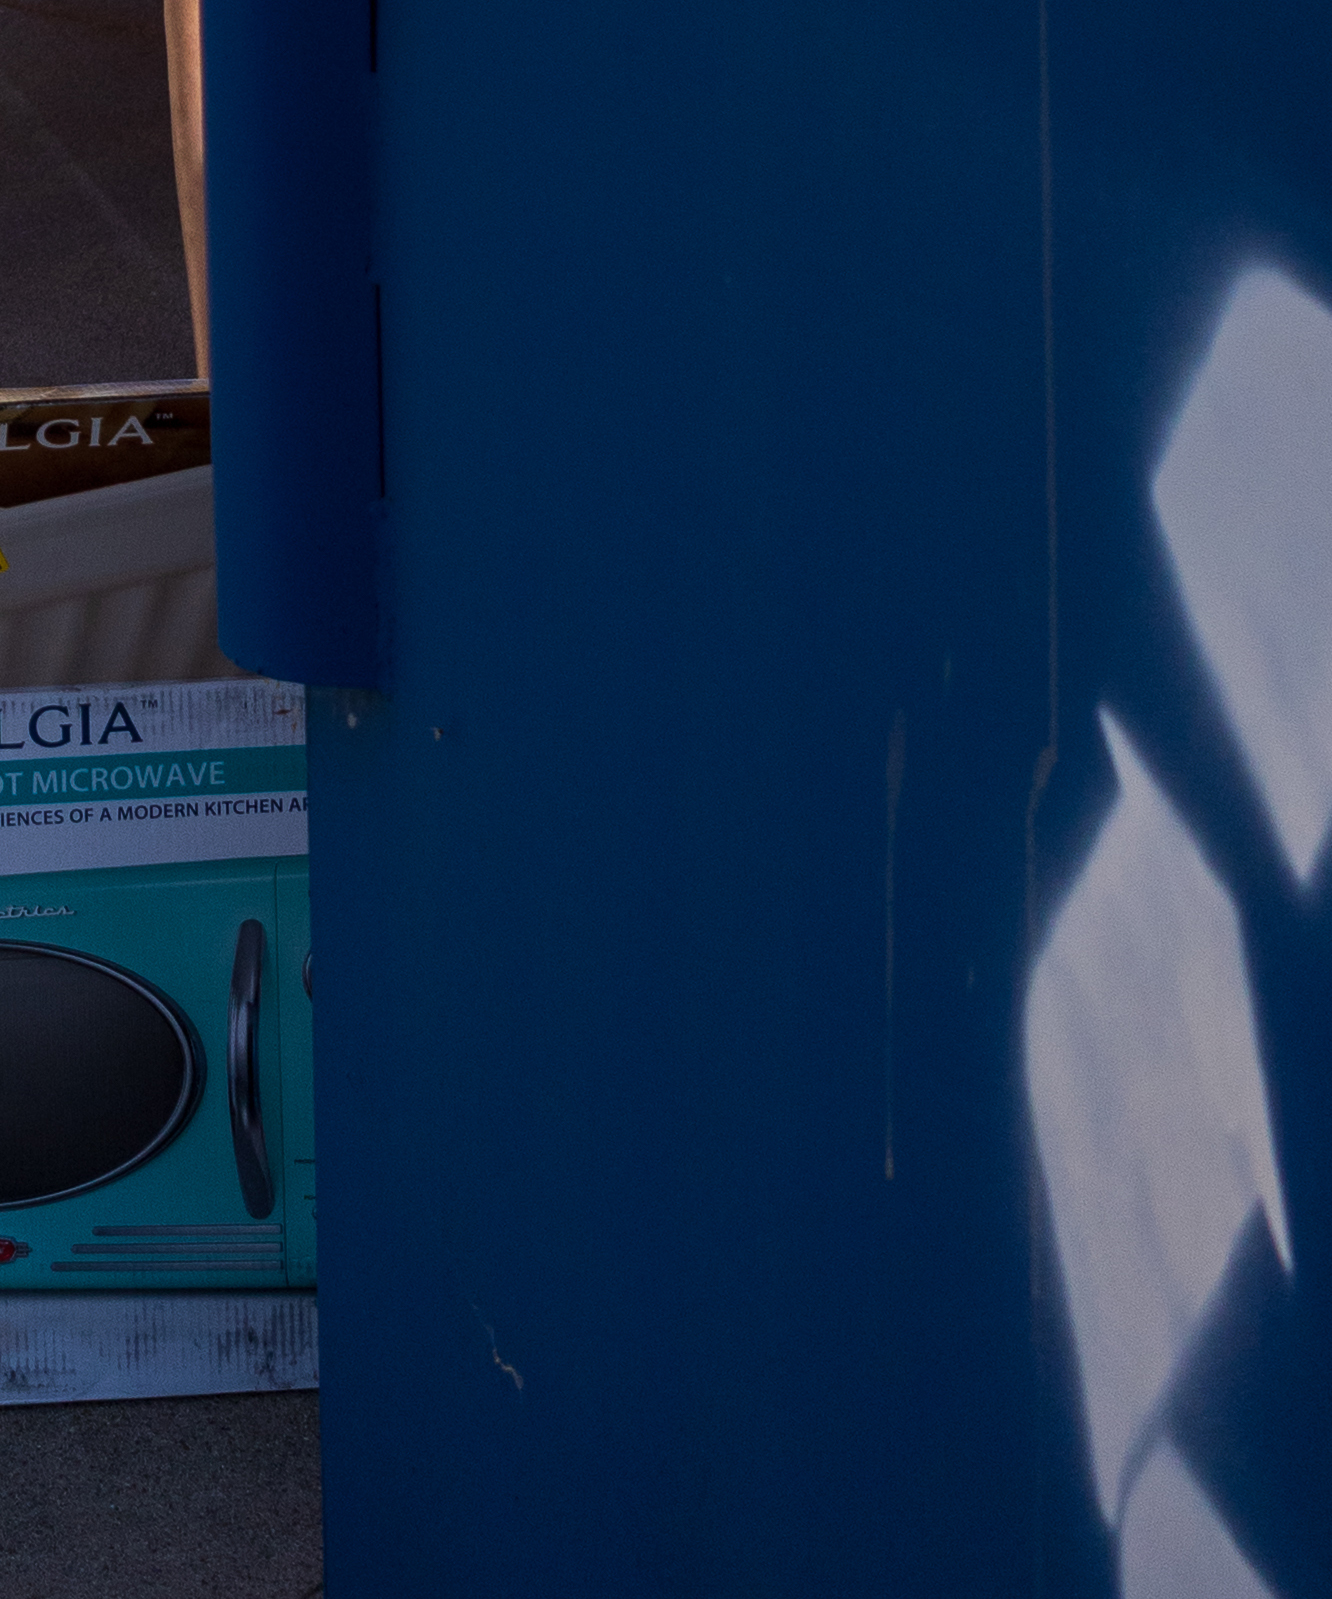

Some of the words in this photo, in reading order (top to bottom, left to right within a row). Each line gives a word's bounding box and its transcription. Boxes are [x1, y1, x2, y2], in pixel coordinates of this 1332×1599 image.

[32, 761, 225, 795] MICROWAVE
[69, 808, 94, 824] OF
[99, 807, 112, 822] A
[117, 802, 198, 821] MODERN
[205, 798, 284, 816] KITCHEN
